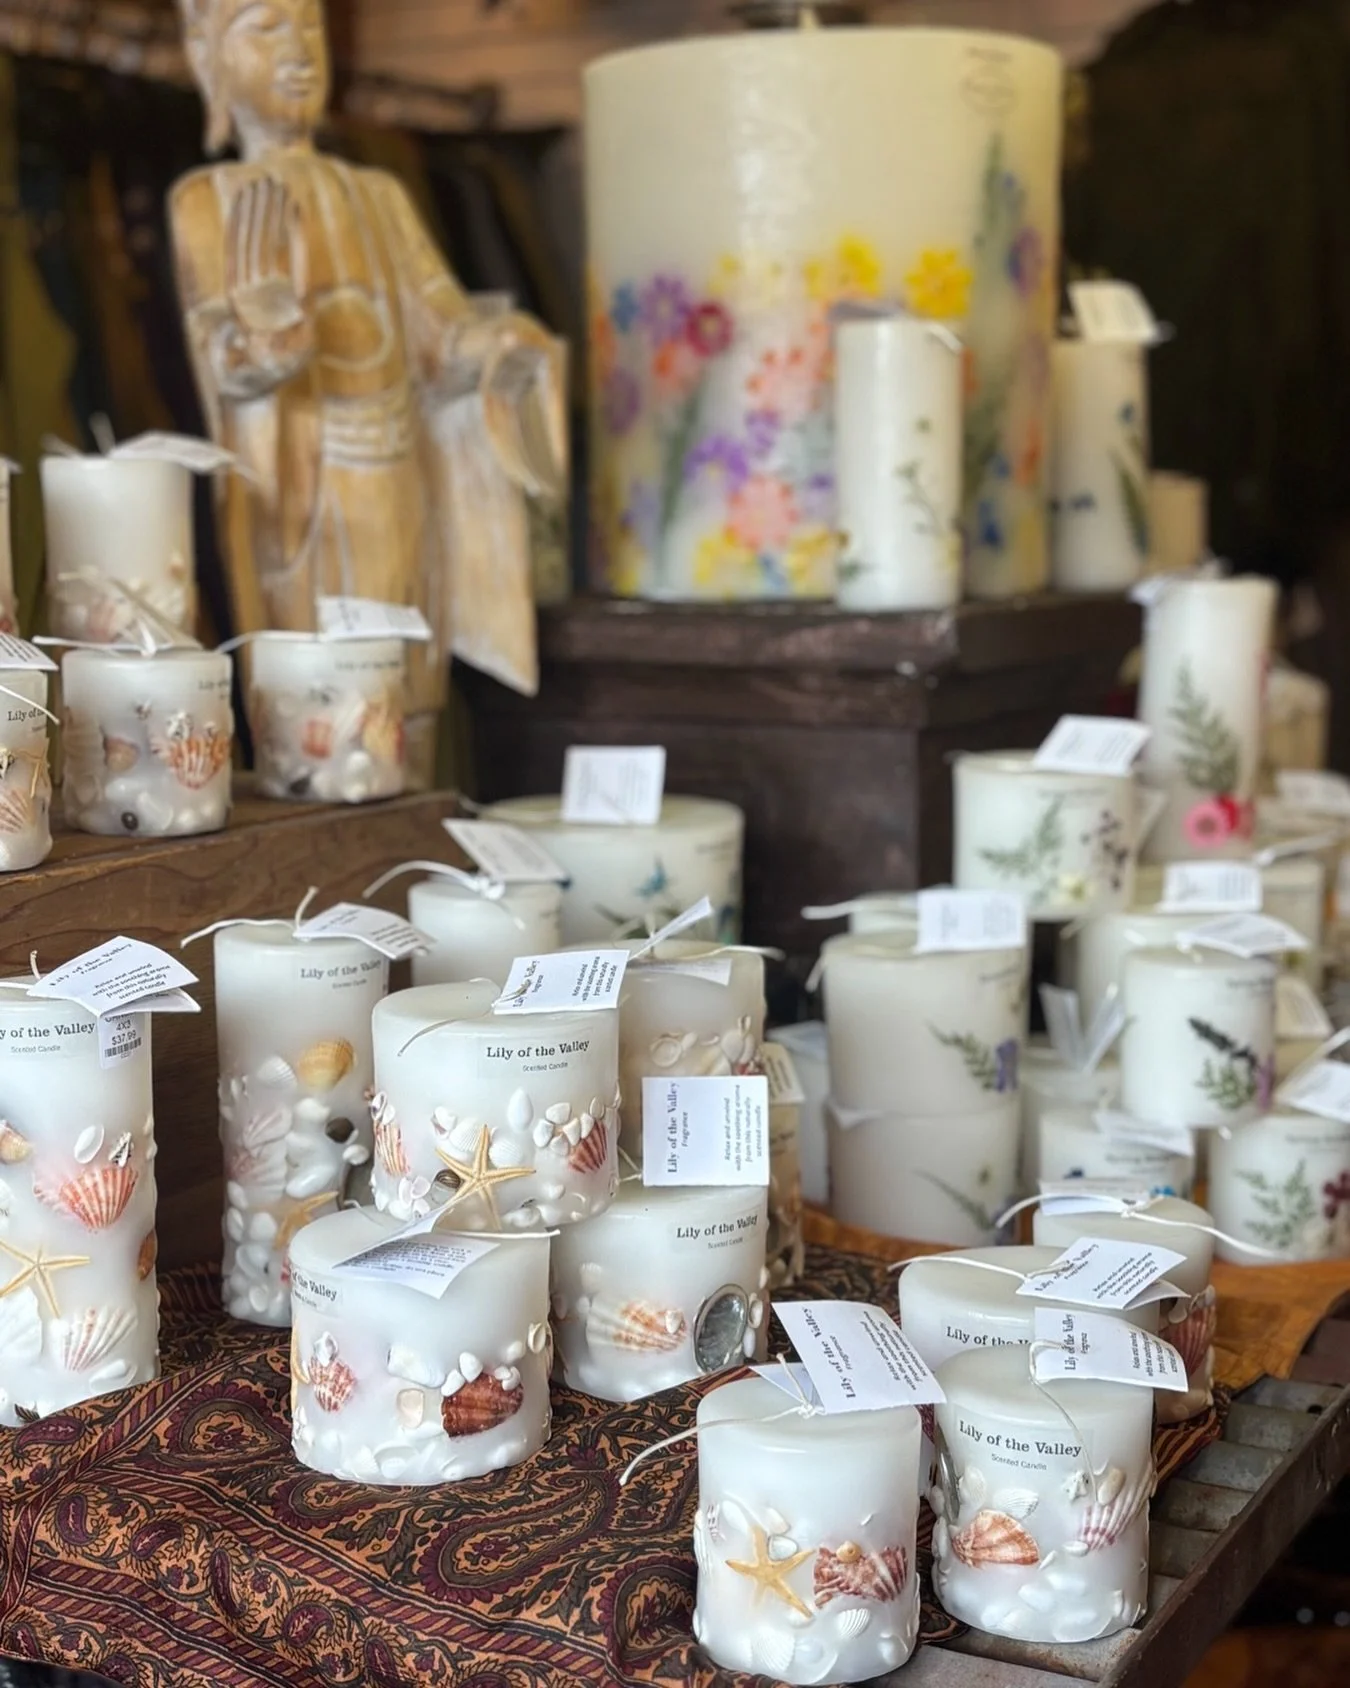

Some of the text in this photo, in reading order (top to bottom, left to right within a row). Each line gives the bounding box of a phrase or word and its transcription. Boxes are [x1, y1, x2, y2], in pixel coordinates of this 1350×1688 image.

[7, 710, 26, 721] Lily
[301, 969, 324, 979] Lily
[328, 967, 339, 976] of
[342, 966, 357, 975] the
[11, 1028, 24, 1038] of
[28, 1026, 50, 1037] the
[54, 1022, 95, 1035] Valley
[487, 1040, 589, 1060] Lily of the Valley
[667, 1083, 678, 1172] Lily of the Valley
[677, 1228, 700, 1239] Lily
[704, 1226, 716, 1236] of
[719, 1223, 734, 1233] the
[309, 1280, 337, 1301] Valley
[946, 1326, 969, 1344] Lily
[974, 1335, 988, 1346] of
[803, 1308, 855, 1397] Lily of the Valley
[1064, 1356, 1077, 1370] Lily
[960, 1421, 1081, 1457] Lily of the Valley
[992, 1454, 1047, 1470] Scented Candle
